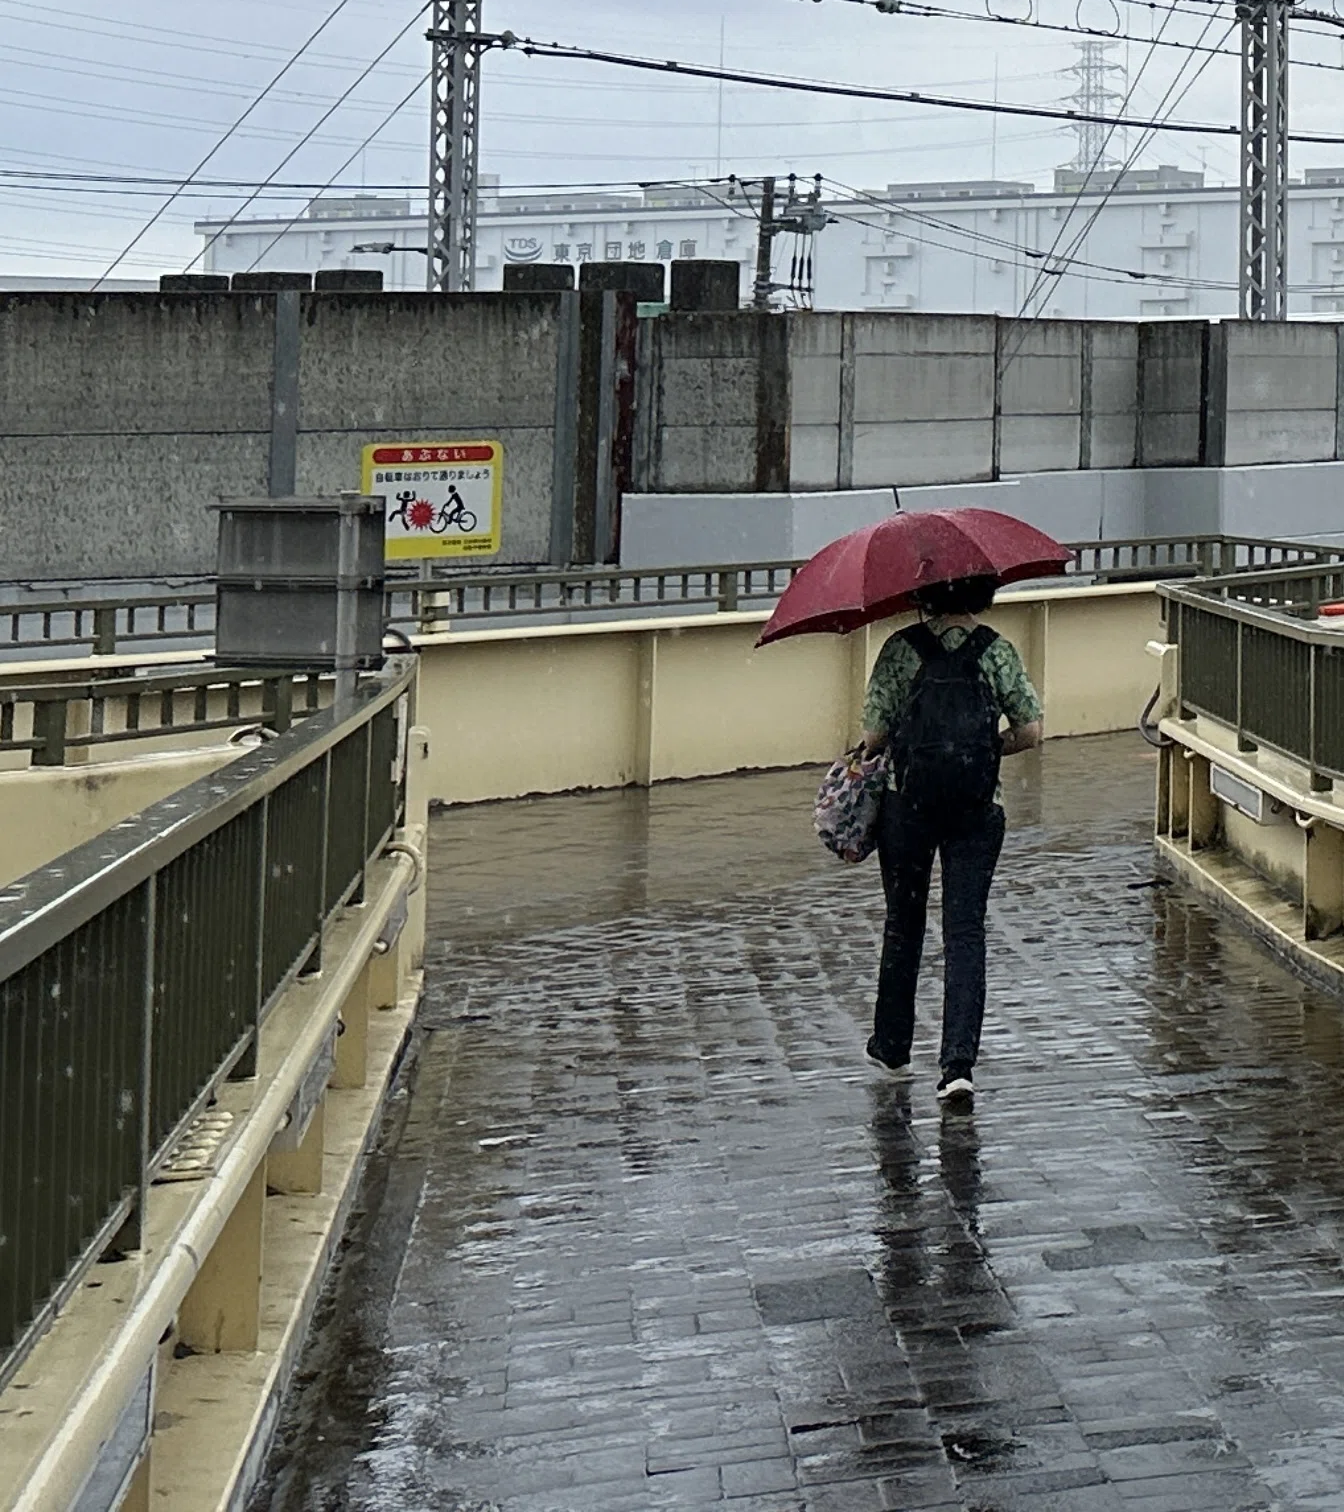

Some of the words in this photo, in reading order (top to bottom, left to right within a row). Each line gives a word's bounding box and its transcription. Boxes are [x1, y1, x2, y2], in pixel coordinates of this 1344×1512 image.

[507, 237, 538, 250] TDS
[552, 239, 698, 263] 東京団地倉庫
[401, 448, 467, 462] あぶない
